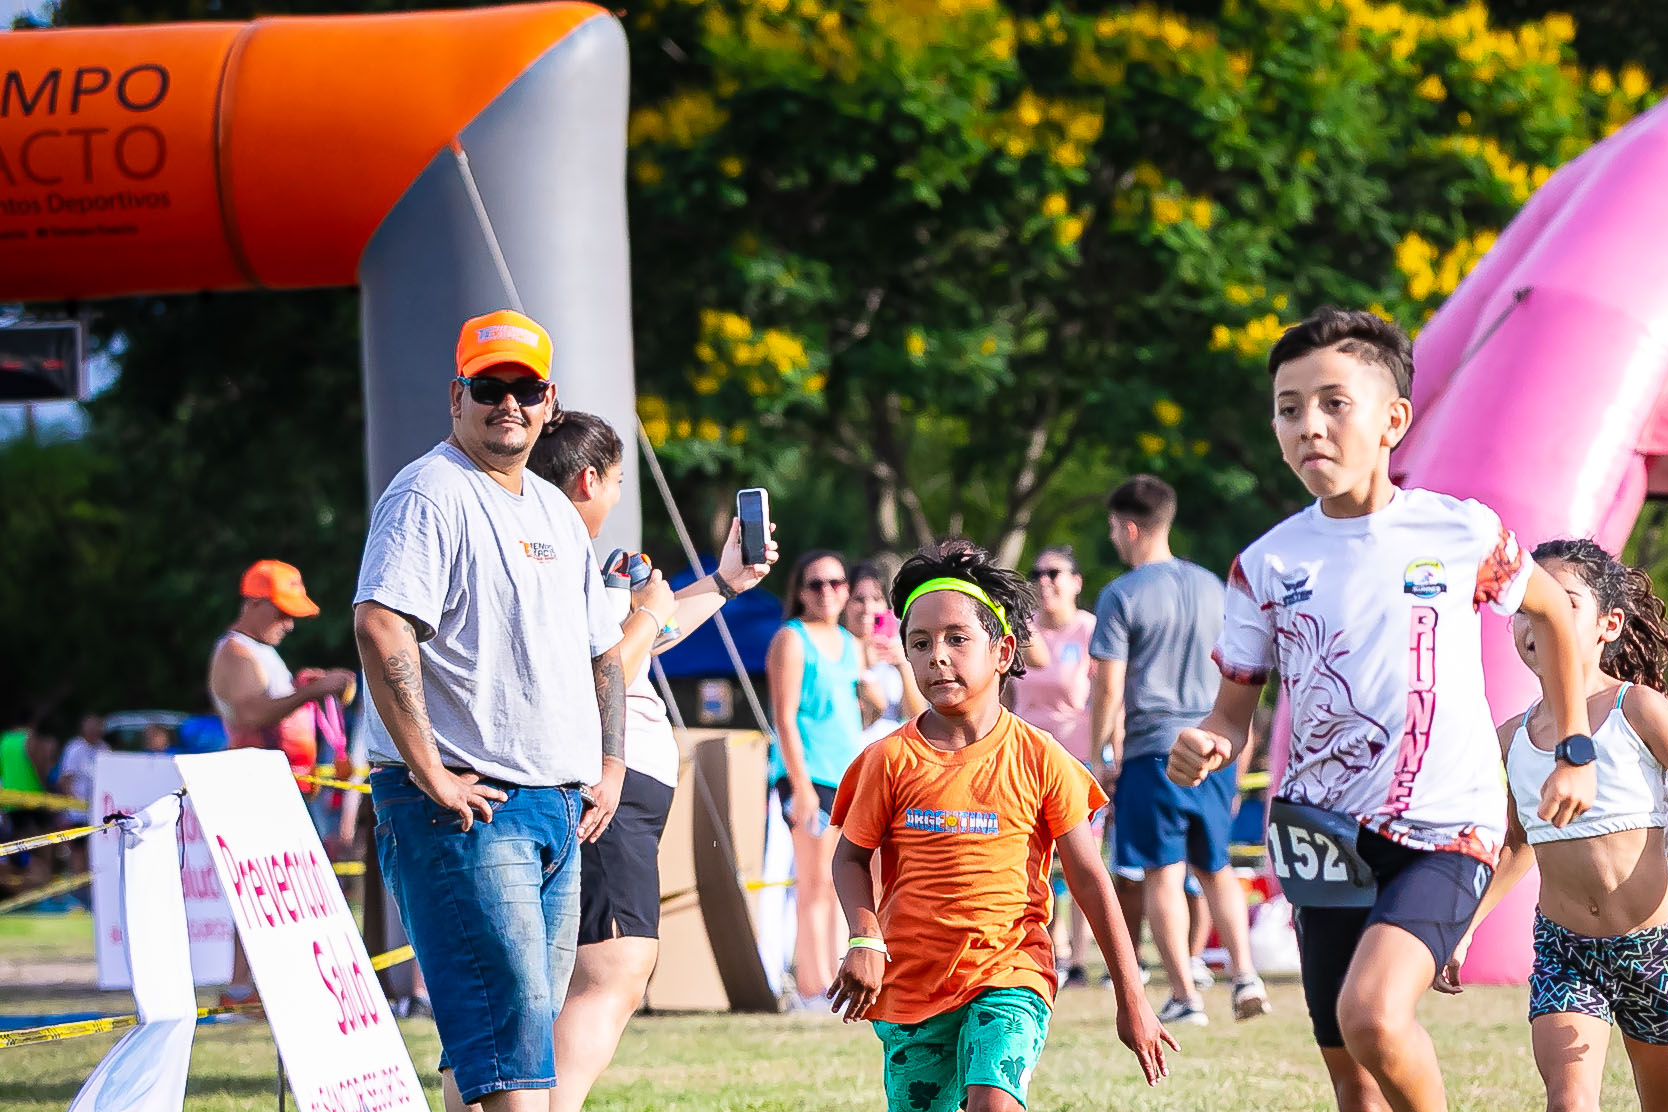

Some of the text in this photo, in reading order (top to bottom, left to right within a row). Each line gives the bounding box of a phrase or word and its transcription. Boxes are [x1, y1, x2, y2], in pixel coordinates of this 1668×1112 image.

[47, 188, 171, 215] Deportivos
[905, 807, 999, 836] ARGENTINA
[1268, 822, 1349, 882] 152
[313, 932, 378, 1036] Salud
